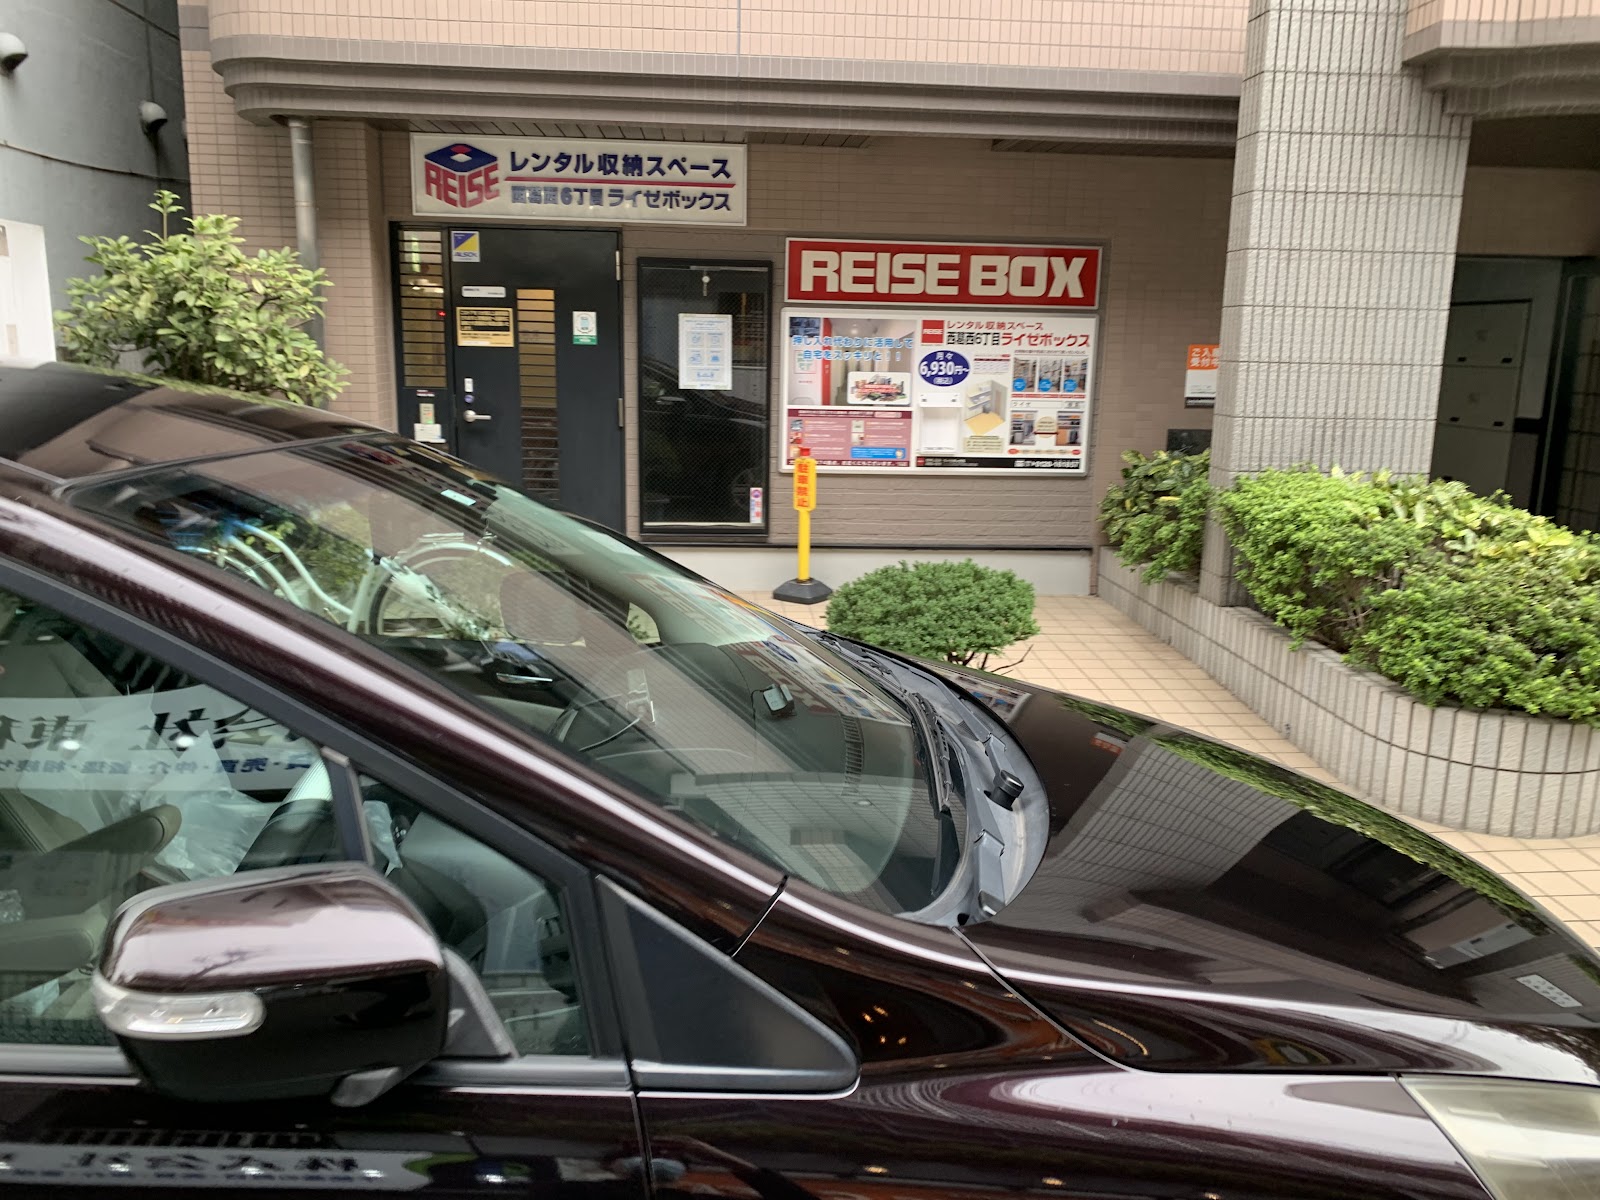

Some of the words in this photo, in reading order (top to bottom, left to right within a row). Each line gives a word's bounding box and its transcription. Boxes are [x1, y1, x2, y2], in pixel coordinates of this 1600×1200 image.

[509, 151, 732, 179] レンタル収納スペース
[424, 161, 500, 208] REISE
[800, 249, 961, 295] REISE
[968, 255, 1088, 298] BOX
[946, 320, 1044, 331] レンタル収納スペース
[792, 335, 914, 349] 押し入れ代わりに活用して
